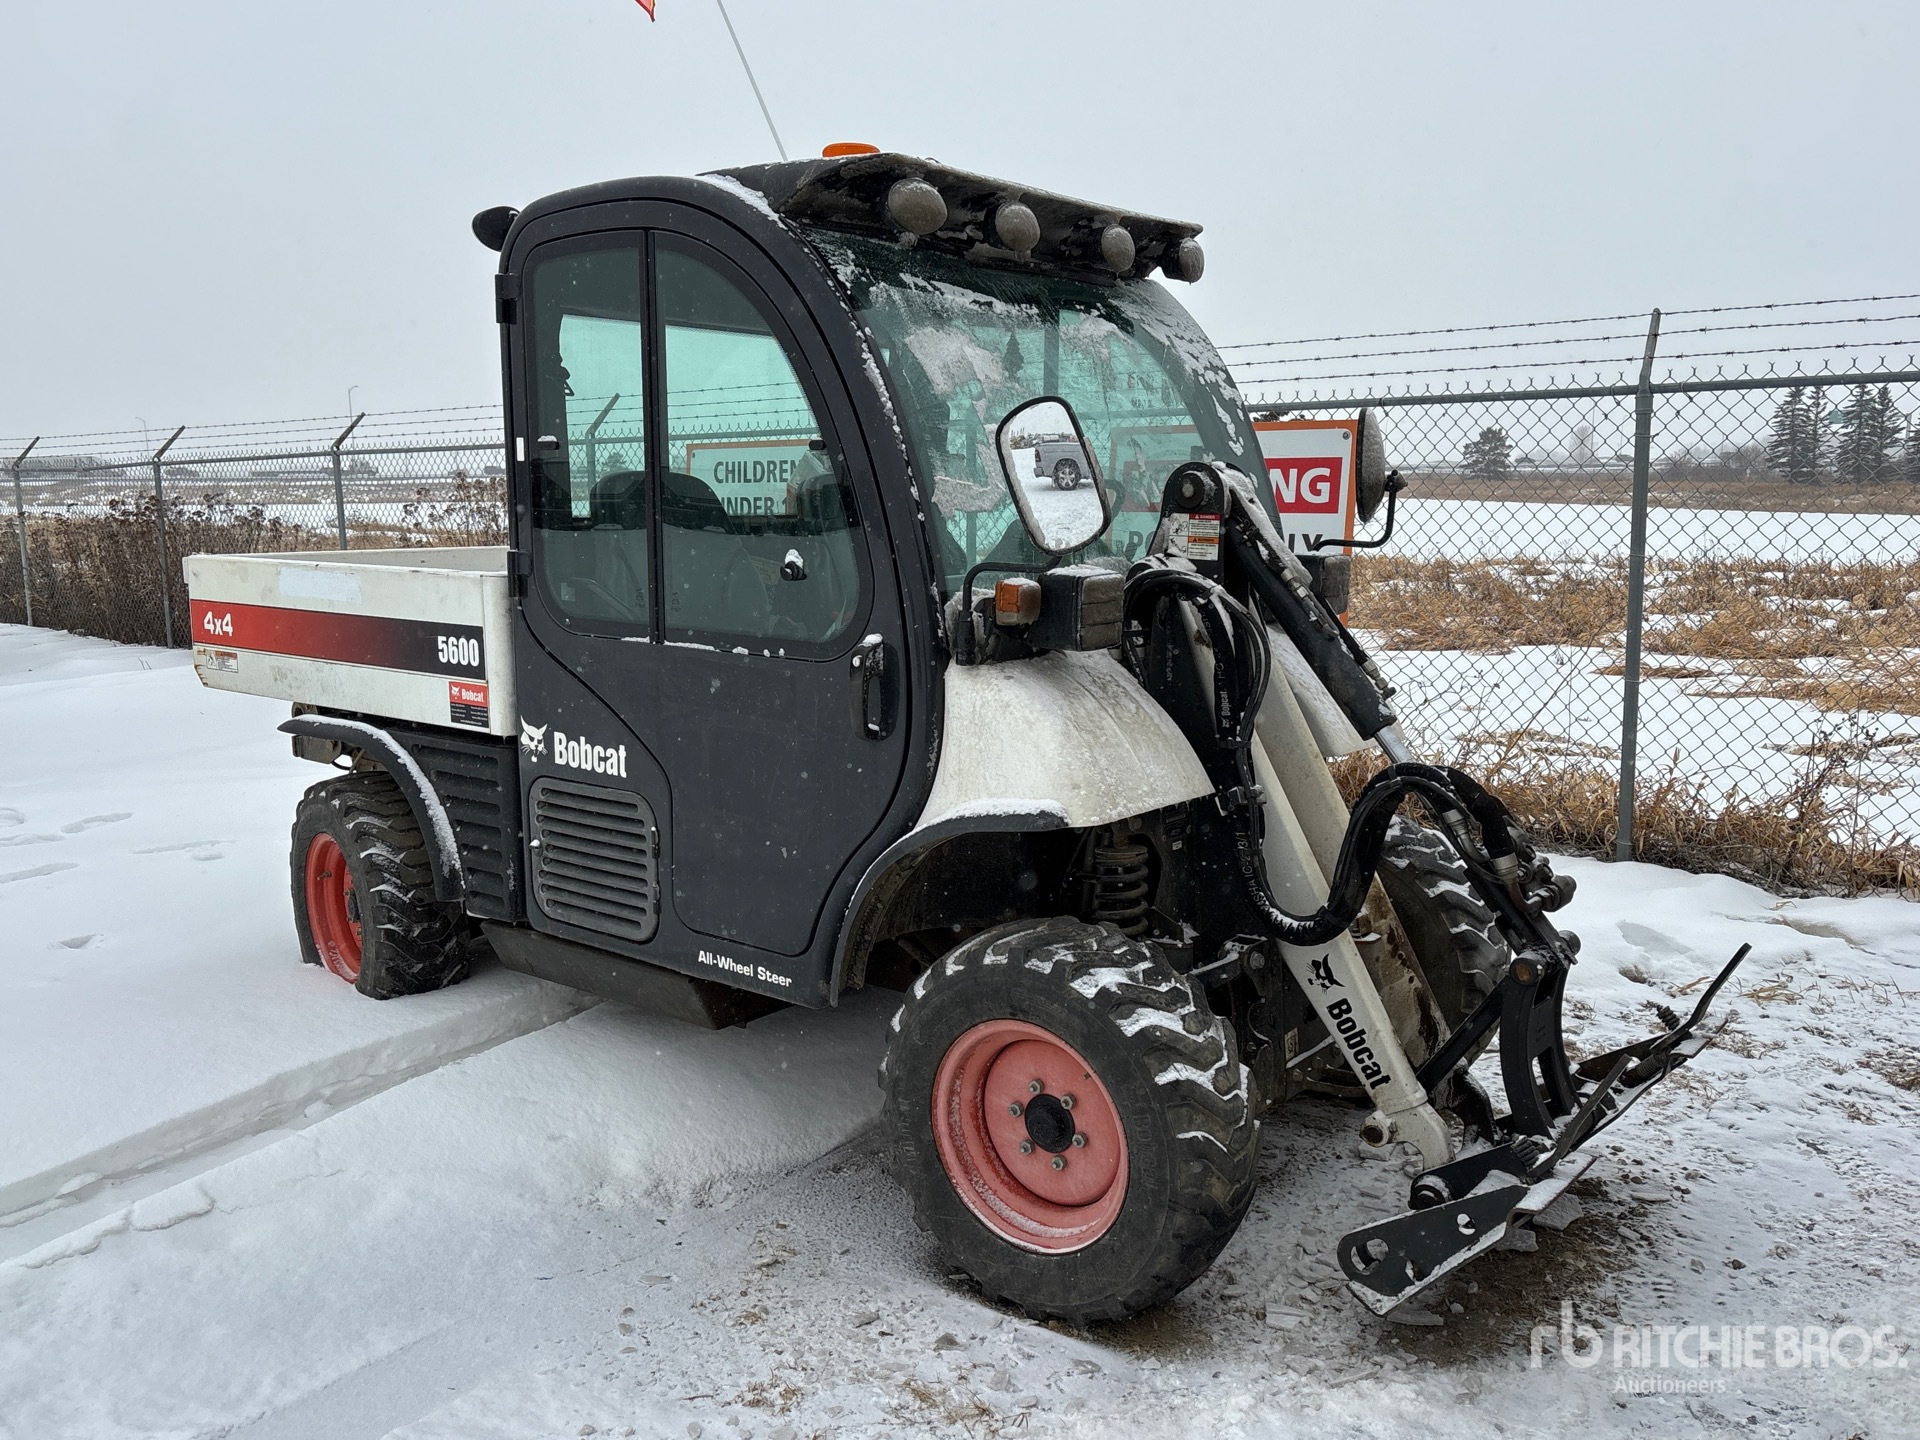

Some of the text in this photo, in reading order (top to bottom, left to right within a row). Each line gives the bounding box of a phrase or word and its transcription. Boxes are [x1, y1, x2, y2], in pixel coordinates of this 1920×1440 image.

[203, 611, 233, 637] 4x4
[437, 635, 480, 667] 5600
[461, 688, 485, 703] Bobcat
[1220, 690, 1232, 716] Bobcat
[553, 731, 627, 779] Bobcat
[698, 950, 793, 988] All-Wheel Steer
[1326, 998, 1391, 1090] Bobcat
